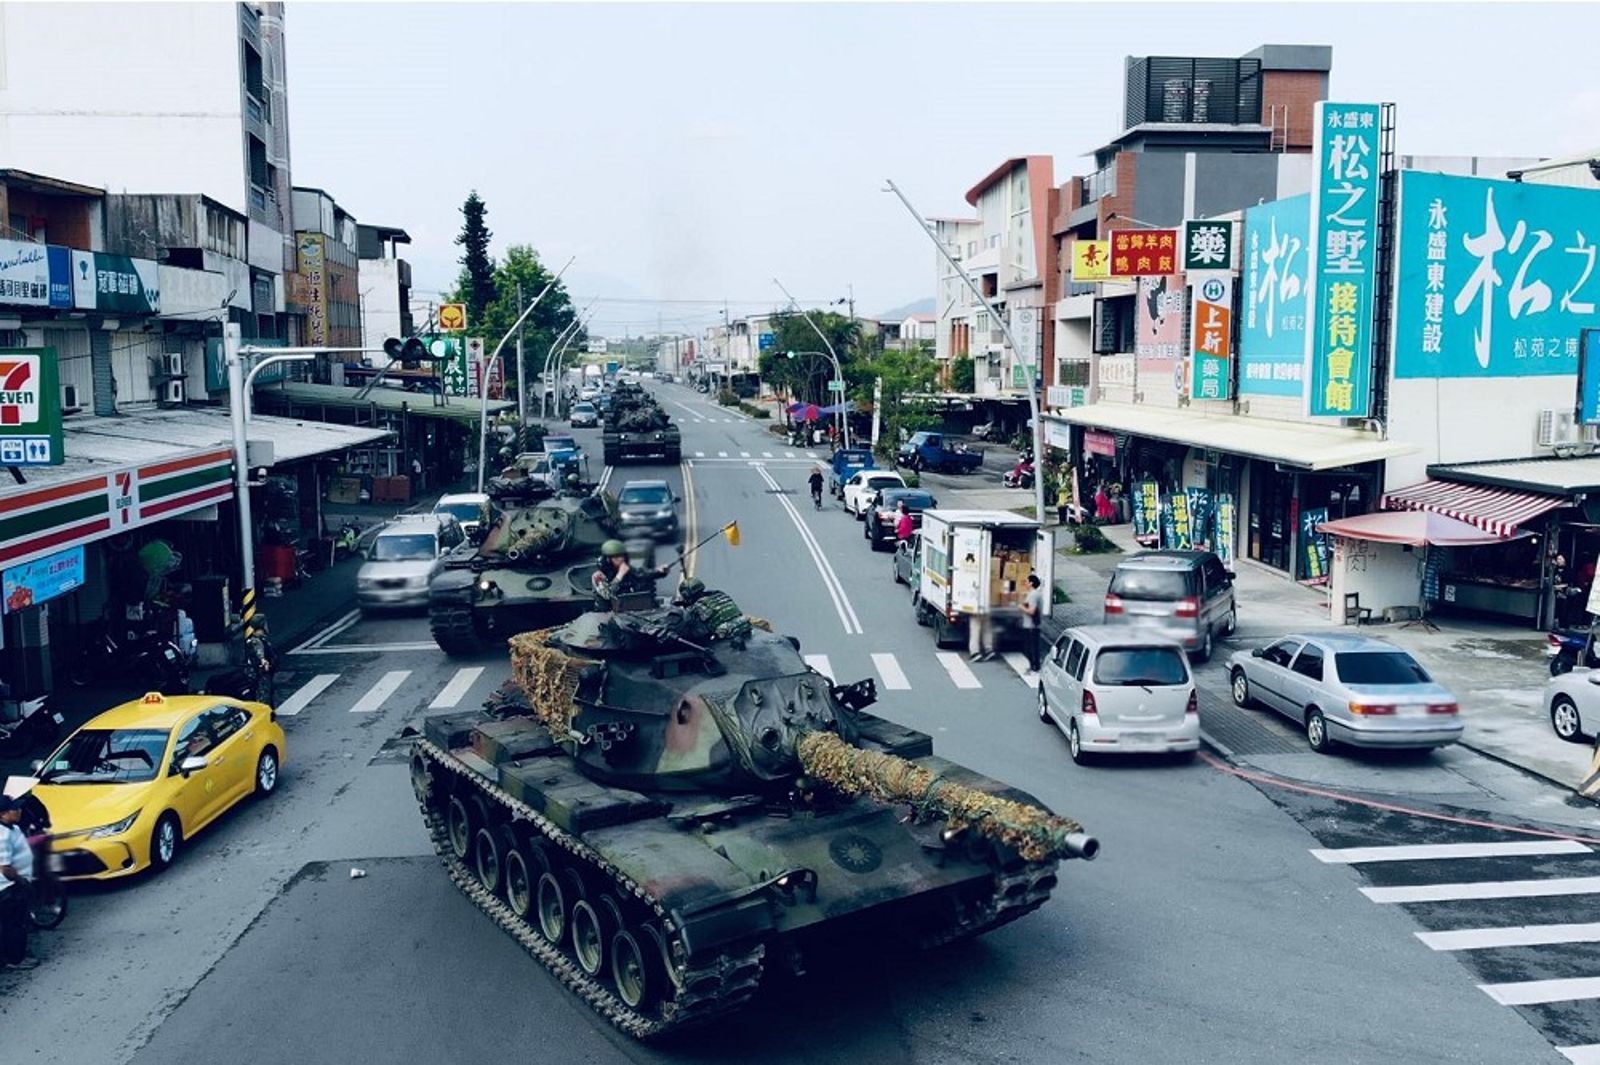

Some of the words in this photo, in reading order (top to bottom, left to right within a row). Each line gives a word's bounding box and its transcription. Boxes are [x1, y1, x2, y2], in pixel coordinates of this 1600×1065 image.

[1328, 111, 1373, 128] 永盛東
[1325, 134, 1370, 273] 松之墅
[1116, 234, 1173, 250] 當歸羊肉
[1190, 226, 1226, 264] 藥
[1116, 256, 1173, 272] 鴨肉飯
[1423, 198, 1447, 353] 永盛東建設
[1326, 282, 1357, 411] 接待會館
